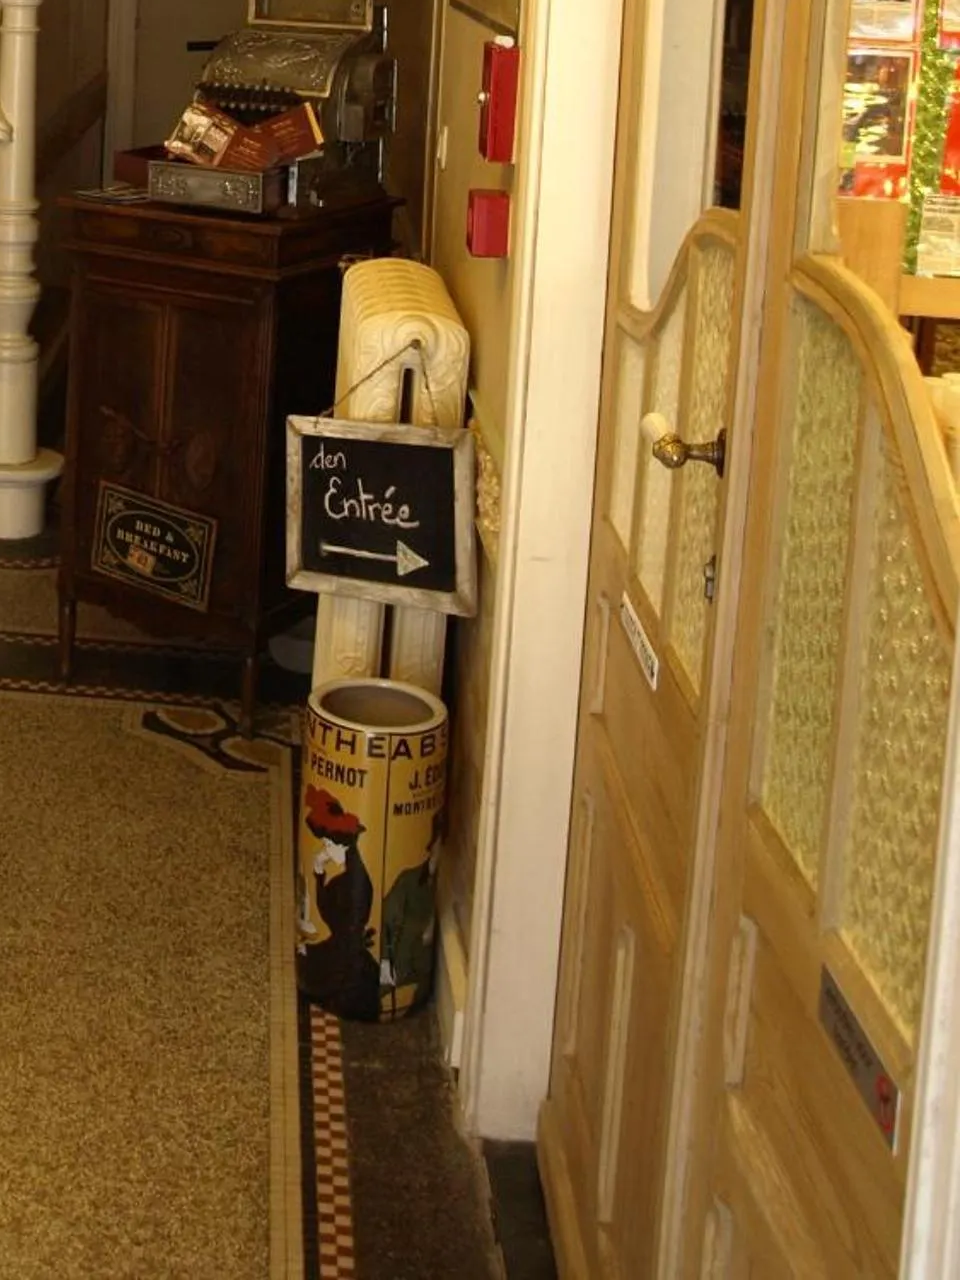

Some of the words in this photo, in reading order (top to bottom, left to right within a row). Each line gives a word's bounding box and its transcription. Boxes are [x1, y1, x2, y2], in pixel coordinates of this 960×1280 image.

[309, 442, 346, 470] den
[323, 475, 420, 528] Entrée
[311, 751, 368, 789] PERNOT
